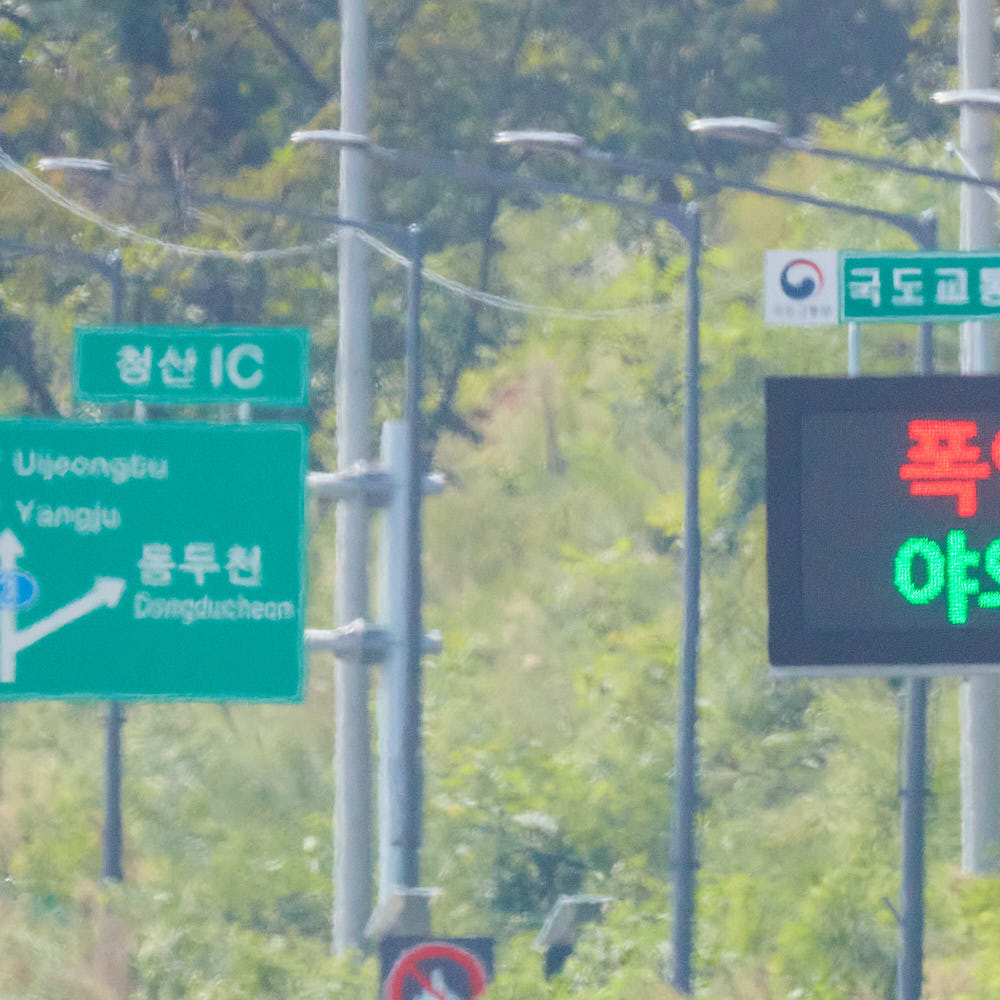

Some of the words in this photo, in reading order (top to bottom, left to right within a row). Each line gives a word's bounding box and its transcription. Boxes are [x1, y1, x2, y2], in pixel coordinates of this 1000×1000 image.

[116, 344, 197, 389] 청산
[210, 342, 265, 390] IC
[12, 448, 169, 485] Uijeongbu
[15, 498, 122, 536] Yangju
[137, 542, 263, 588] 동두천
[133, 591, 295, 625] Dongducheon
